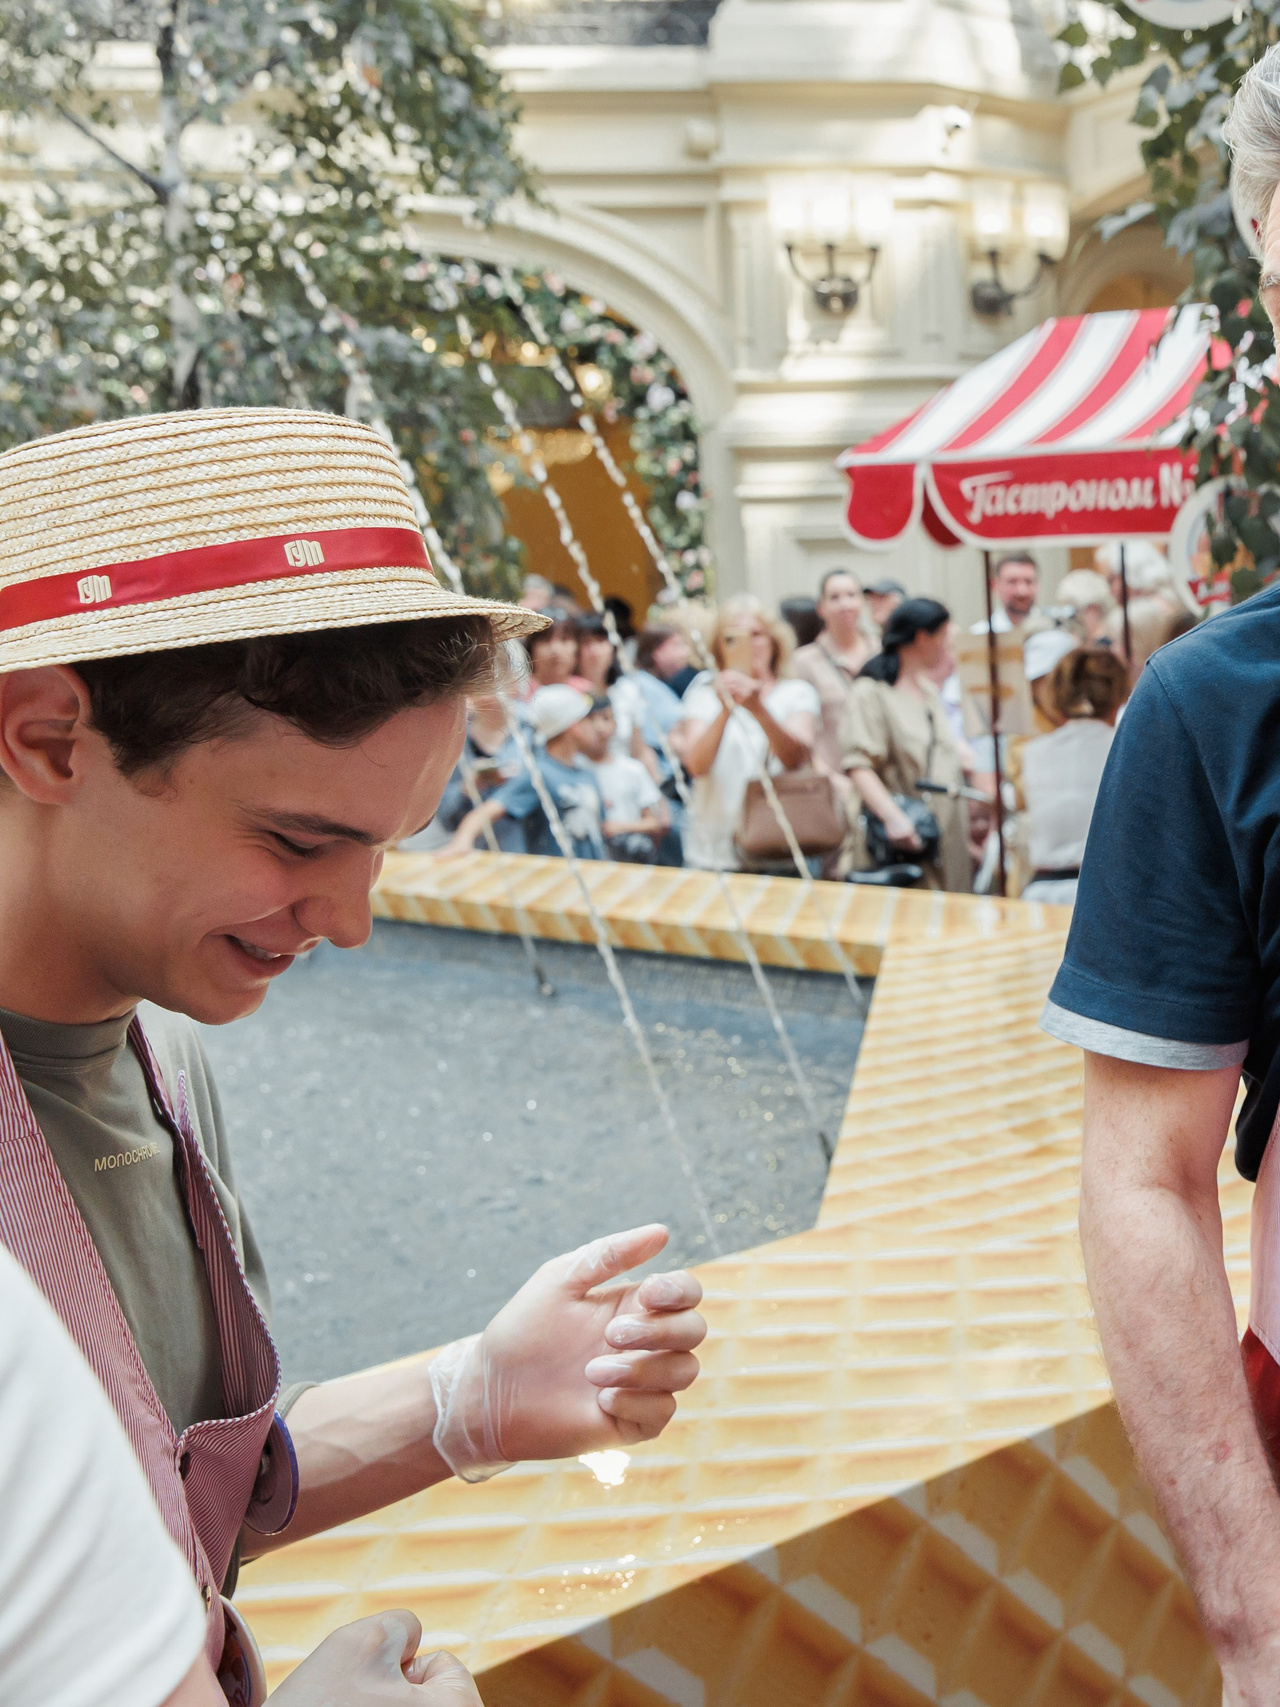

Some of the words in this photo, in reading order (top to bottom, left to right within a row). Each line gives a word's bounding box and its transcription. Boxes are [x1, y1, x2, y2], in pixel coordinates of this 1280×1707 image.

[959, 470, 1156, 525] Гастроном
[283, 539, 325, 568] ГУМ
[76, 574, 112, 605] ГУМ
